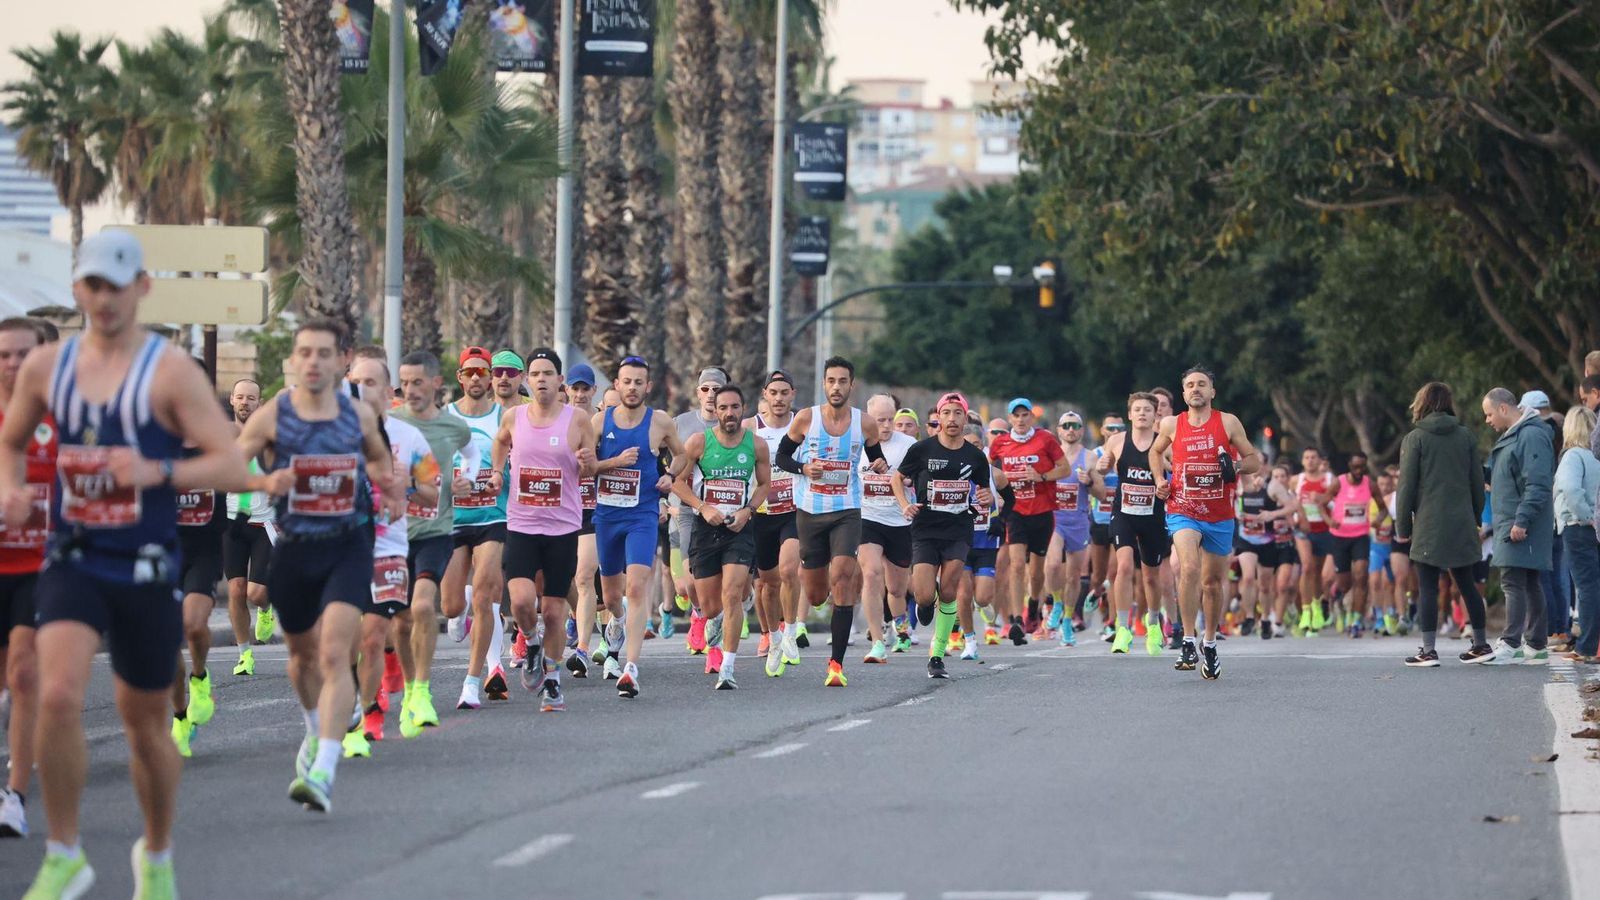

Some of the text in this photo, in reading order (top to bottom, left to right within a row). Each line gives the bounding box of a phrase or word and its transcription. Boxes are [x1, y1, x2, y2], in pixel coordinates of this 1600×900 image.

[530, 469, 560, 477] GENERALI
[711, 466, 748, 478] mijas
[1127, 468, 1153, 480] KICK
[1195, 476, 1214, 484] 7368
[528, 481, 550, 491] 2402
[605, 481, 631, 491] 12893
[176, 494, 200, 504] 819
[712, 491, 736, 500] 10882
[1127, 495, 1147, 503] 14277
